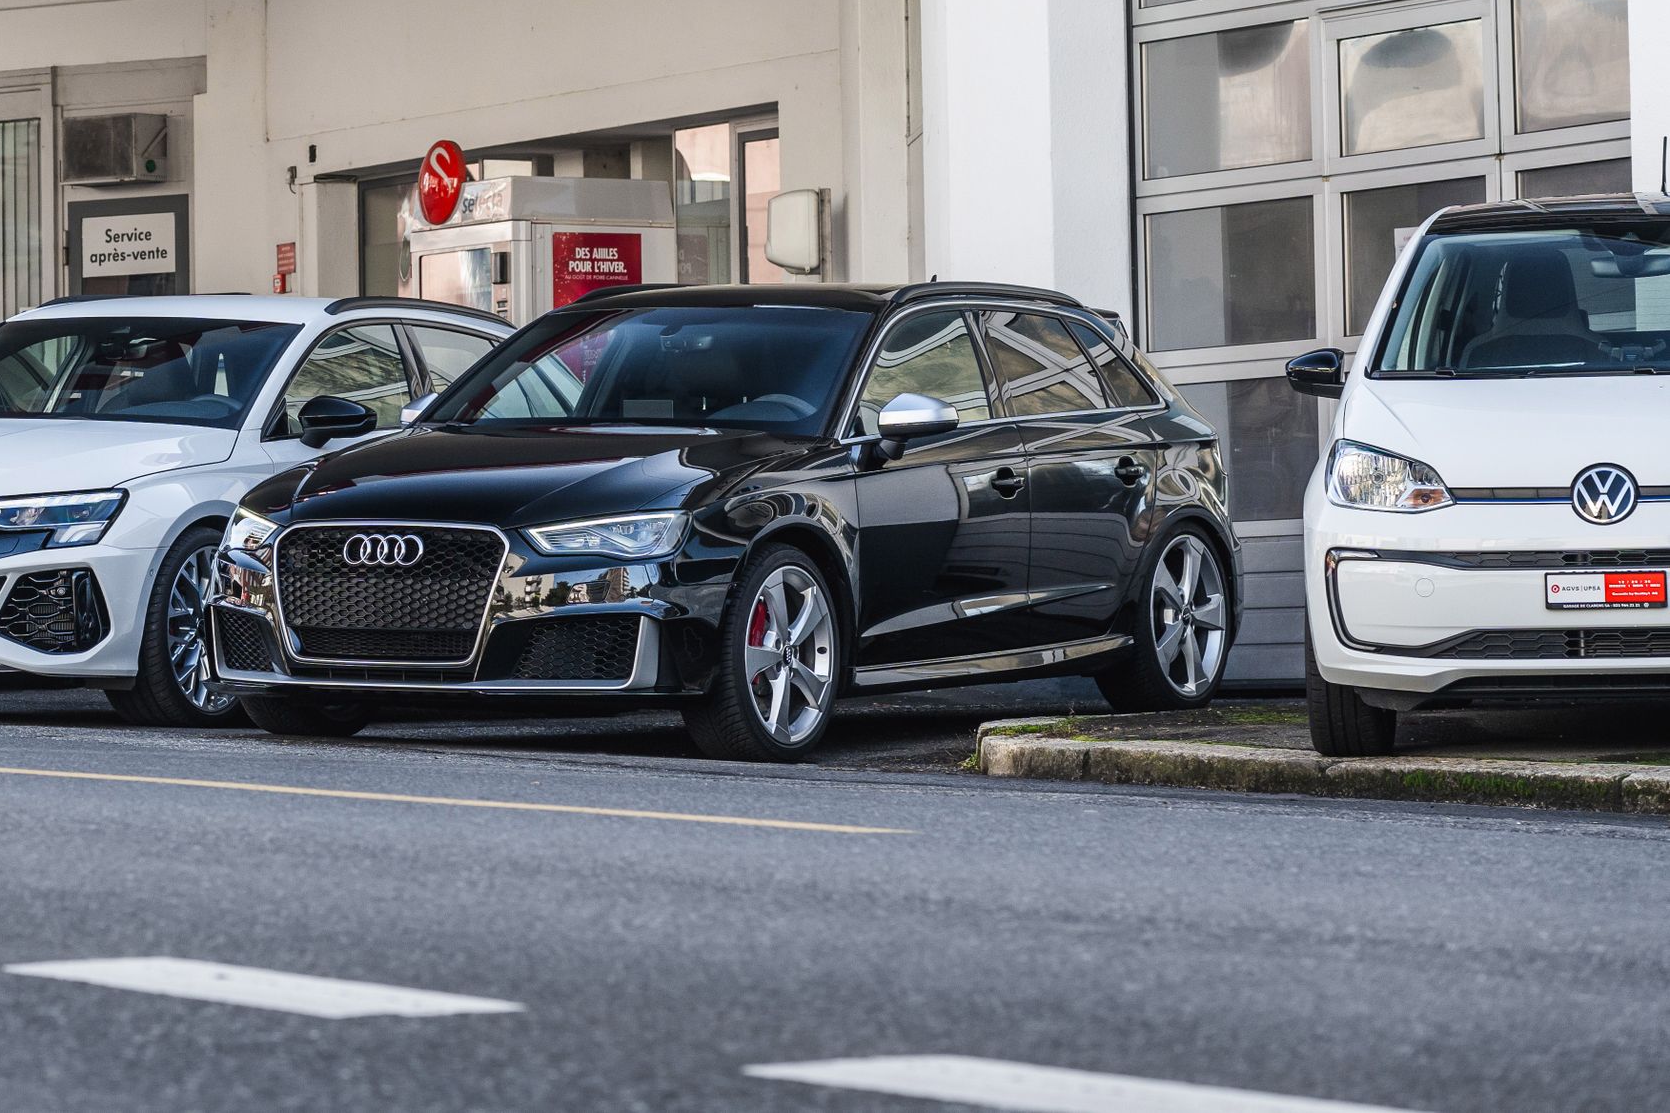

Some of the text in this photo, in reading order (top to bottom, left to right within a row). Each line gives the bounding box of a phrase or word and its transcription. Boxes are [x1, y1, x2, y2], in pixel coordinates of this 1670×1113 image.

[105, 227, 152, 243] Service
[90, 247, 168, 266] après-vente
[575, 247, 590, 259] DES
[569, 260, 592, 273] POUR
